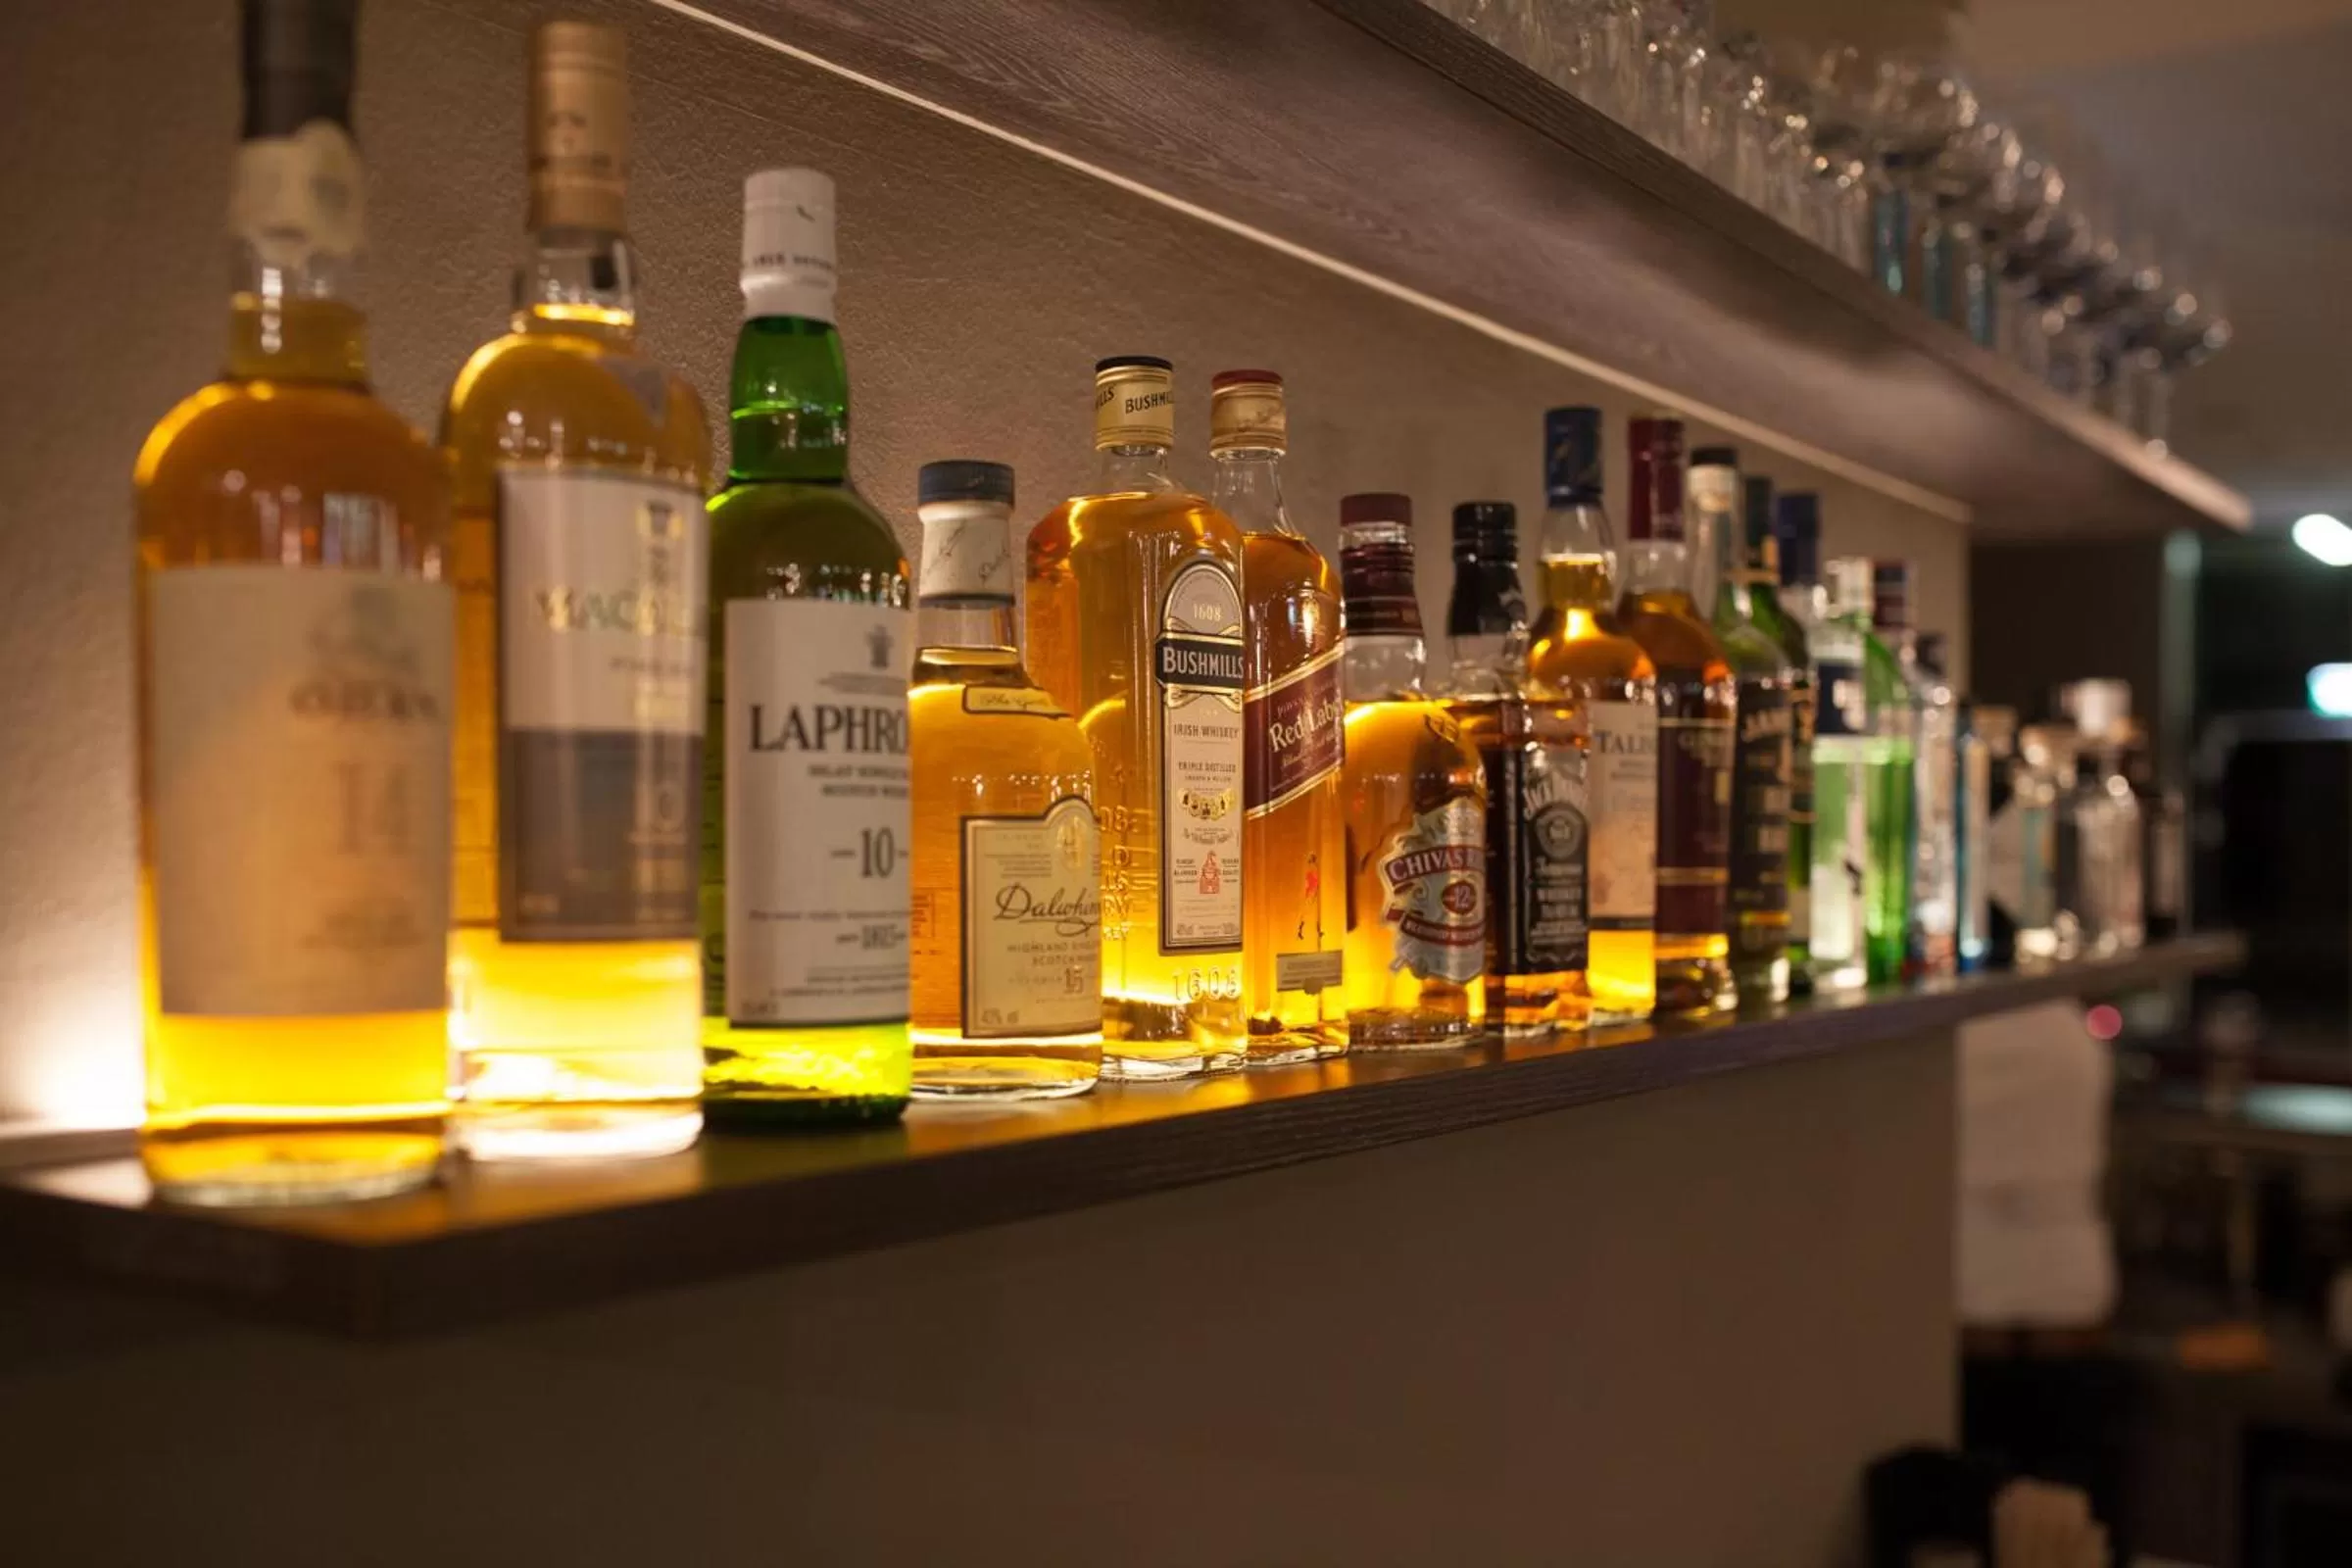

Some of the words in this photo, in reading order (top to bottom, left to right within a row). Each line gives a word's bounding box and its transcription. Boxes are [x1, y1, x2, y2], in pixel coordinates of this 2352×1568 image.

[1194, 603, 1222, 621] 1608
[1162, 646, 1244, 679] BUSHMILLS
[1174, 724, 1199, 737] IRISH
[1269, 712, 1303, 753] Red
[860, 827, 896, 878] 10
[1389, 847, 1465, 881] CHIVAS
[1453, 885, 1469, 909] 12
